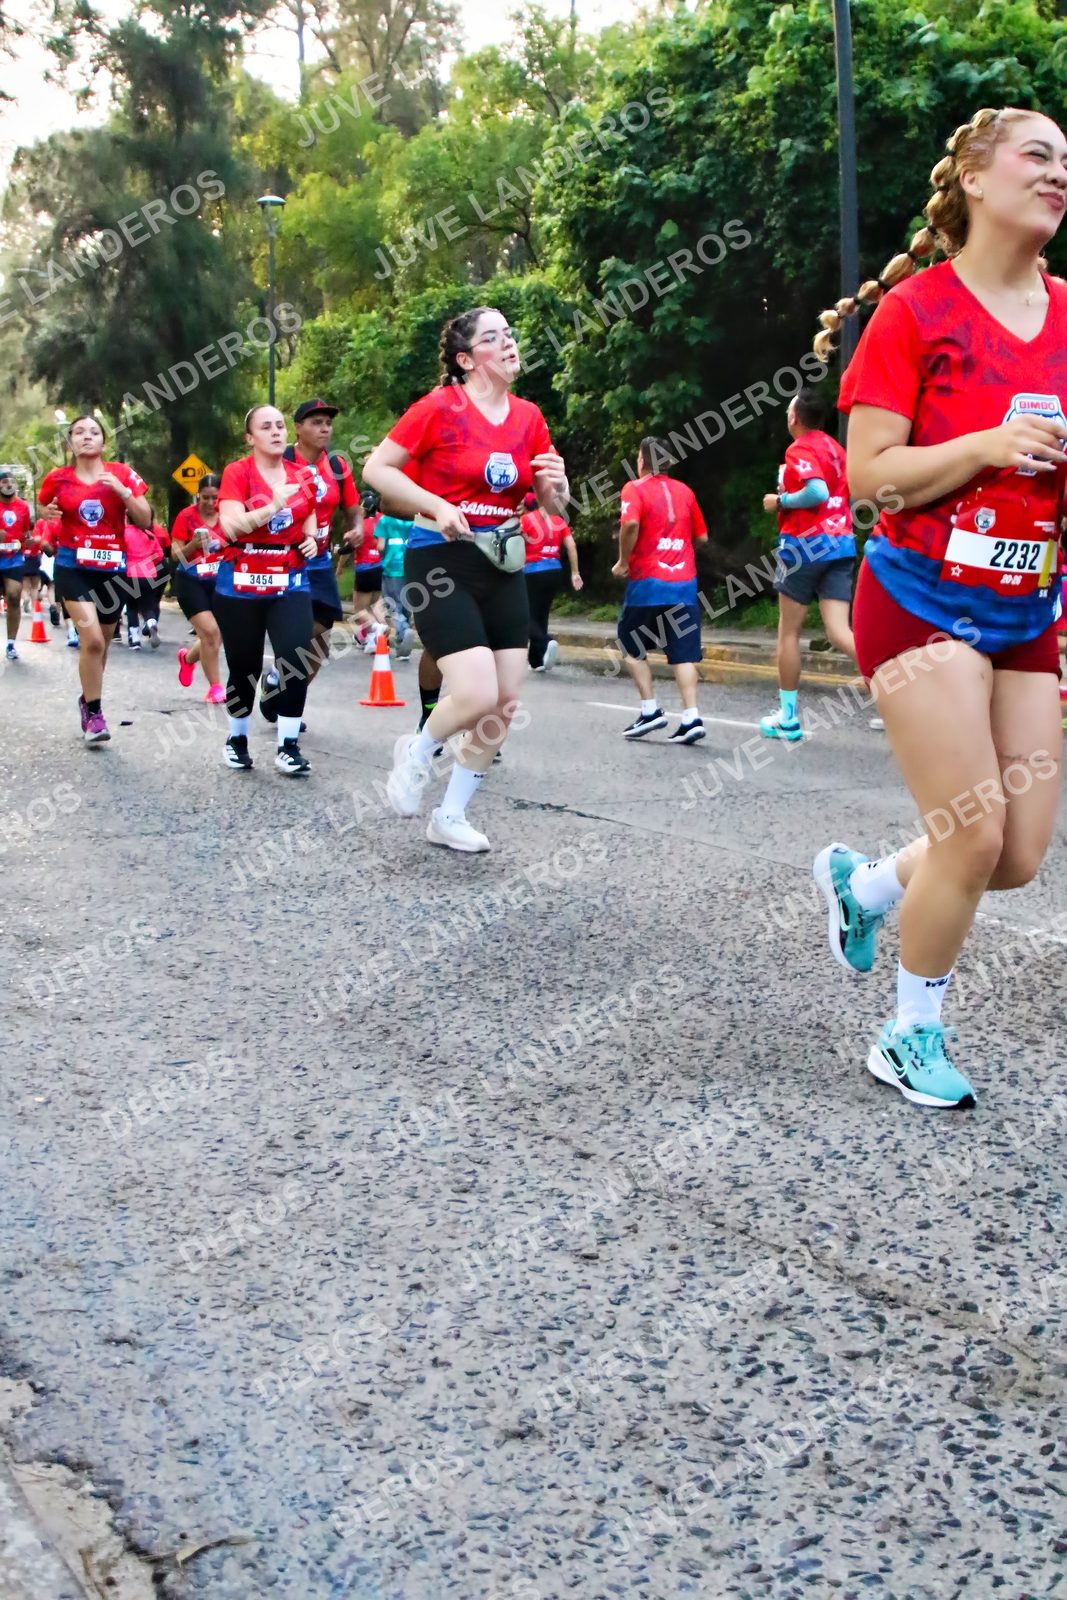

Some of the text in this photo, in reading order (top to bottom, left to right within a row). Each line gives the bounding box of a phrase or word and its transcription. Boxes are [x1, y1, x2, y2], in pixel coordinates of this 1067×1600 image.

[1019, 401, 1055, 411] BIMBO
[93, 550, 112, 560] 1435
[989, 540, 1041, 570] 2232
[250, 574, 273, 585] 3454
